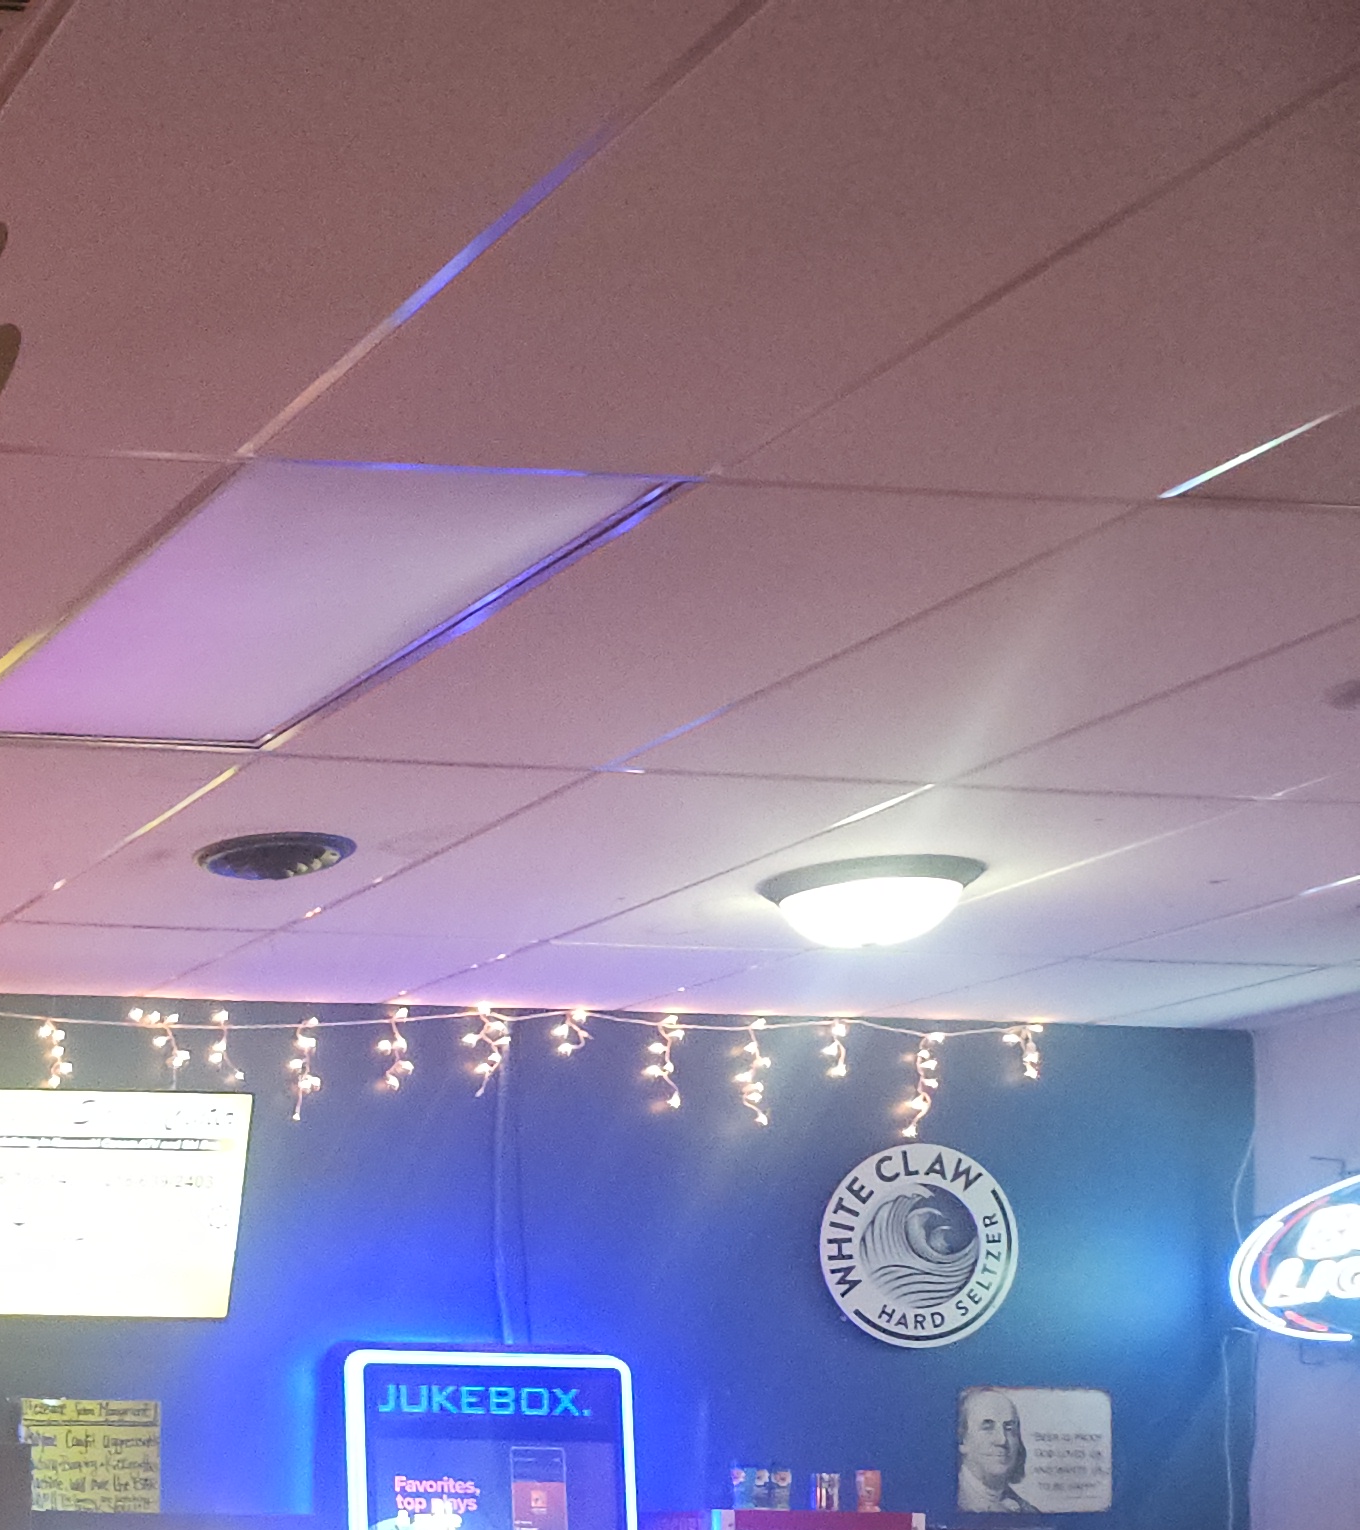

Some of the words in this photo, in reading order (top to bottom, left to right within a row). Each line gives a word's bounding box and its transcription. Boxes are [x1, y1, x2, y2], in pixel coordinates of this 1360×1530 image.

[827, 1176, 875, 1298] WHITE
[875, 1150, 983, 1191] CLAW
[878, 1304, 945, 1330] HARD
[955, 1213, 1002, 1316] SELTZER
[394, 1475, 480, 1496] Favorites,
[396, 1494, 427, 1513] top
